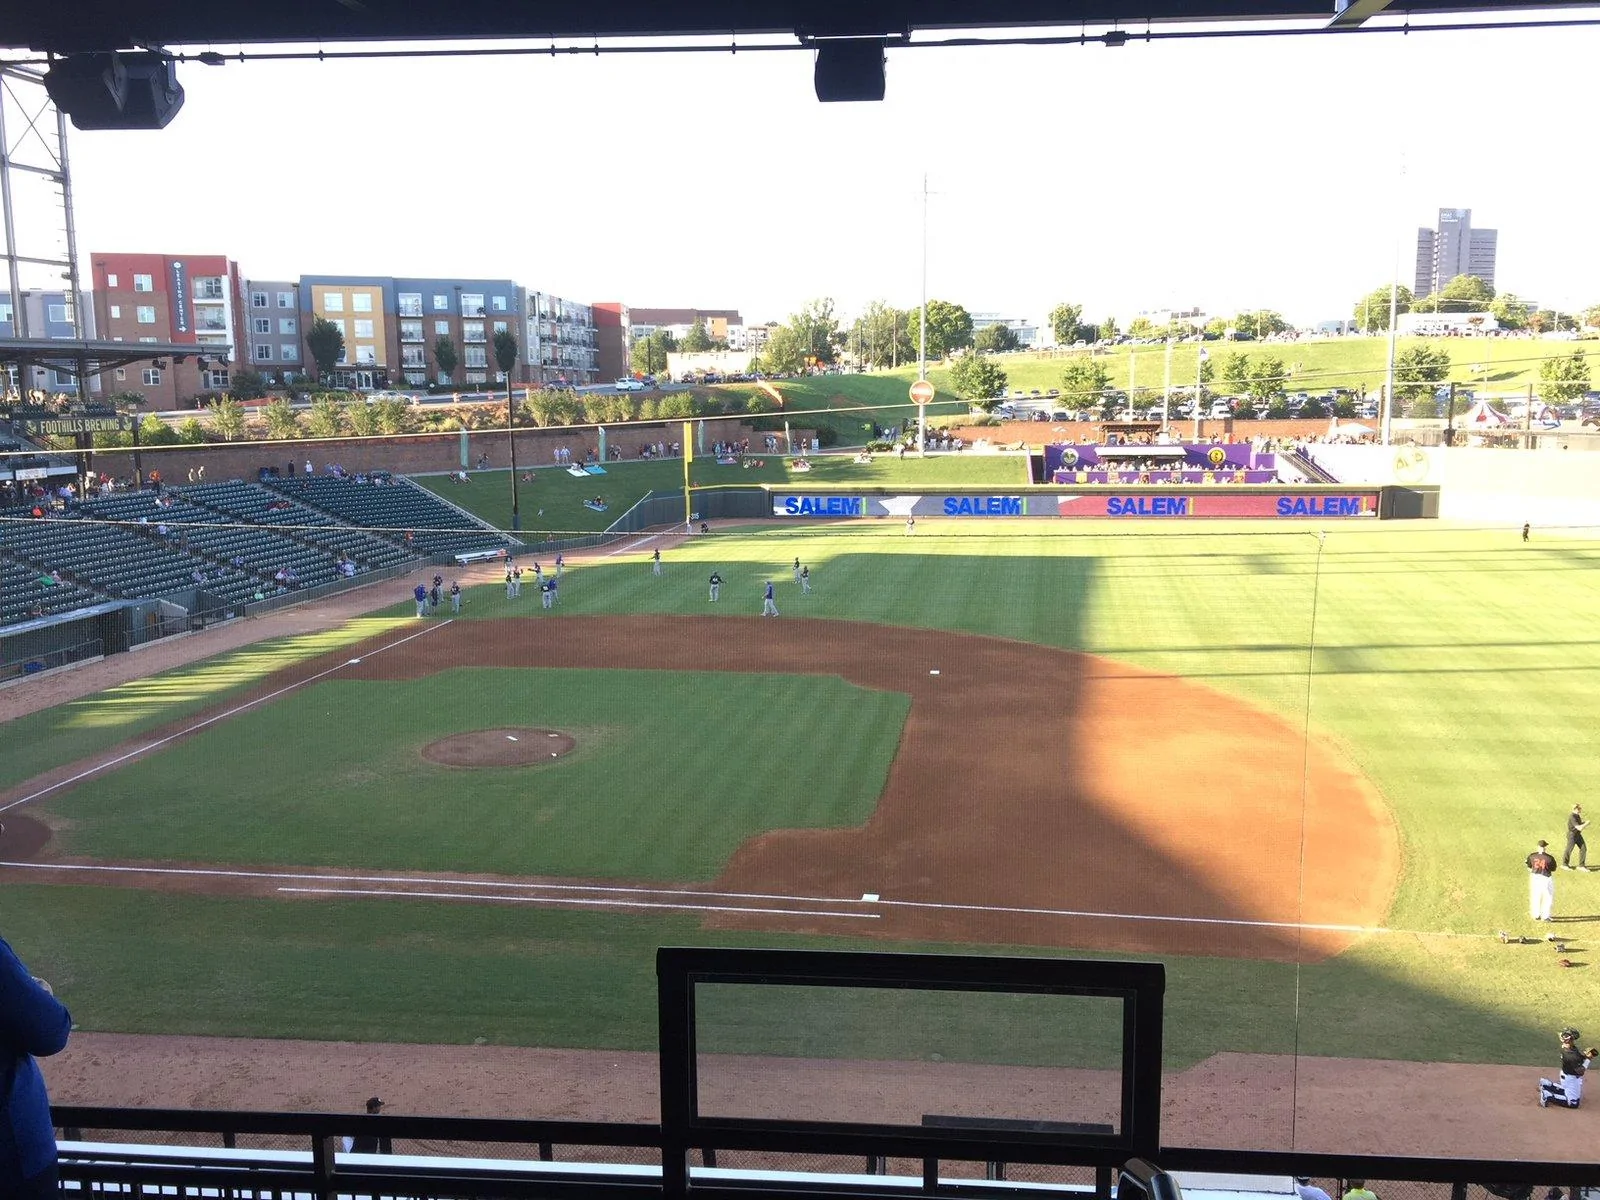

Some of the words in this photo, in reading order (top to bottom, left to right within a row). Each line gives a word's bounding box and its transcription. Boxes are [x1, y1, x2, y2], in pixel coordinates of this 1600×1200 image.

[175, 269, 183, 299] LEASING
[40, 420, 82, 434] FOOTHILLS
[84, 418, 120, 432] BREWING
[785, 496, 861, 515] SALEM
[943, 496, 1021, 516] SALEM
[1106, 496, 1188, 516] SALEM
[1275, 496, 1359, 516] SALEM
